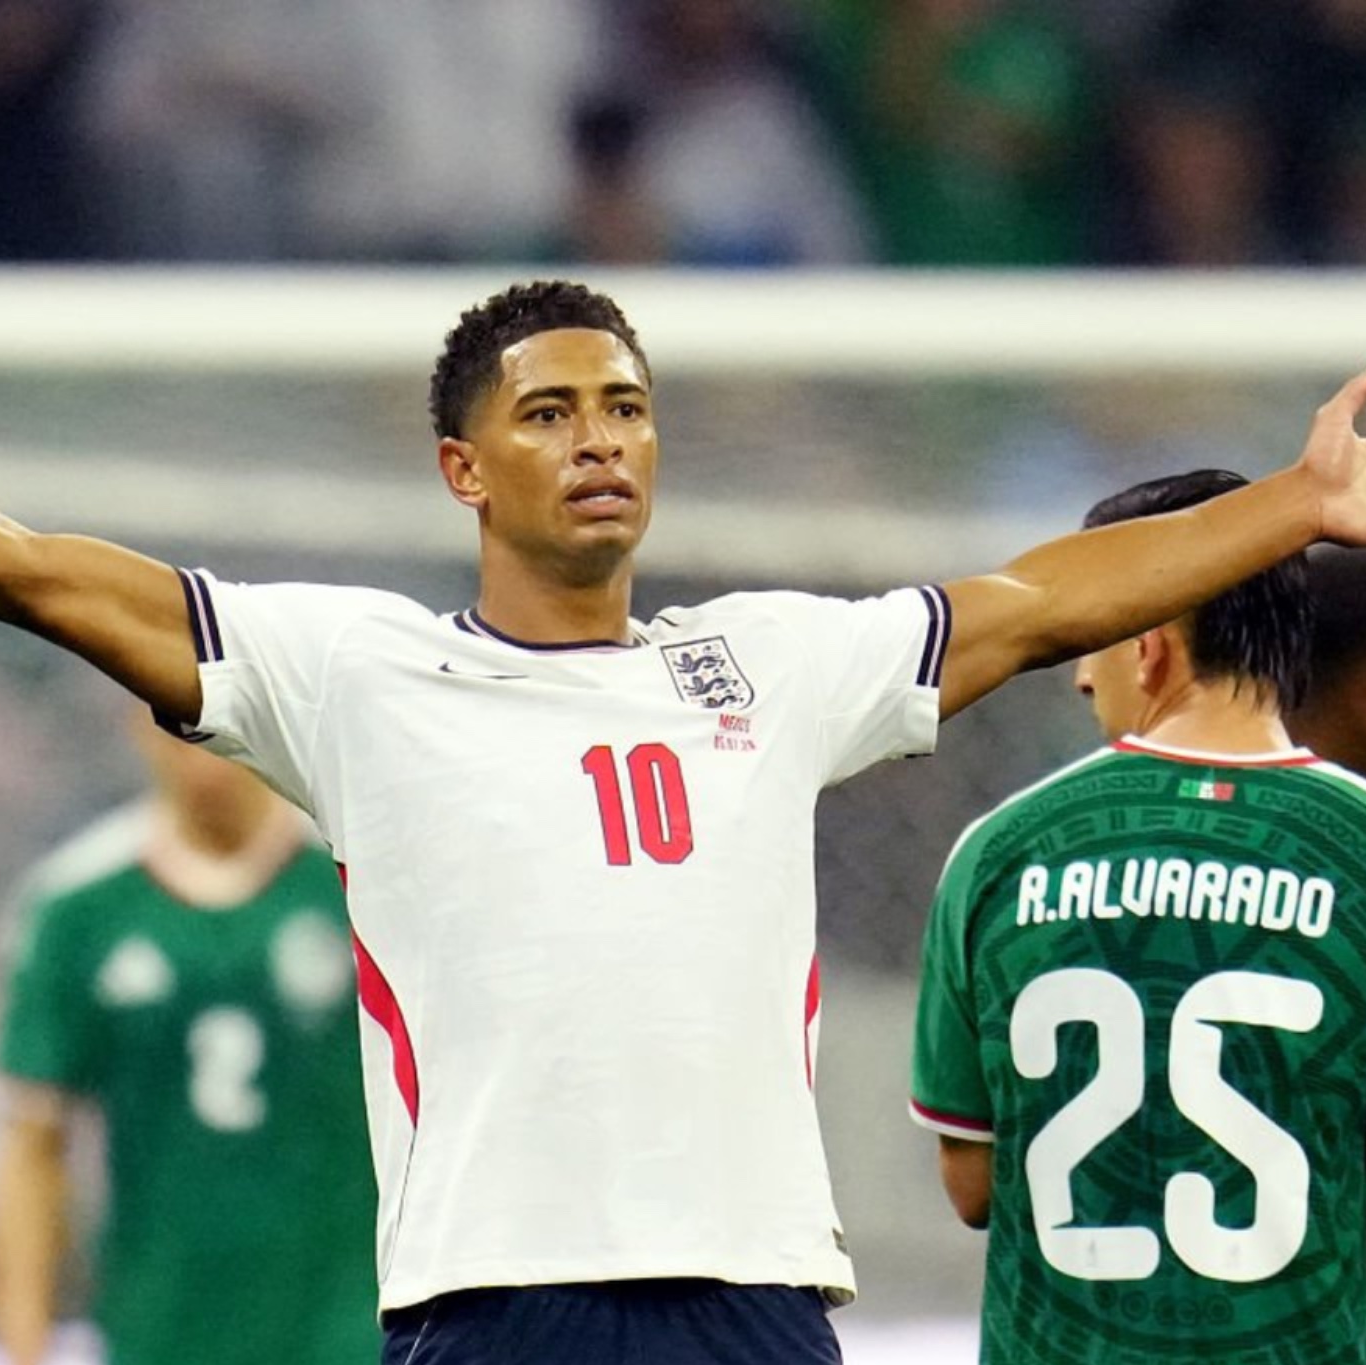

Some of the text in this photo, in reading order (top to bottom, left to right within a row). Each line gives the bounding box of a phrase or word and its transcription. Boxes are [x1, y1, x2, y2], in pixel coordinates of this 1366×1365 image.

[580, 742, 694, 866] 10
[1016, 857, 1336, 939] R.ALVARADO
[1009, 966, 1325, 1283] 25
